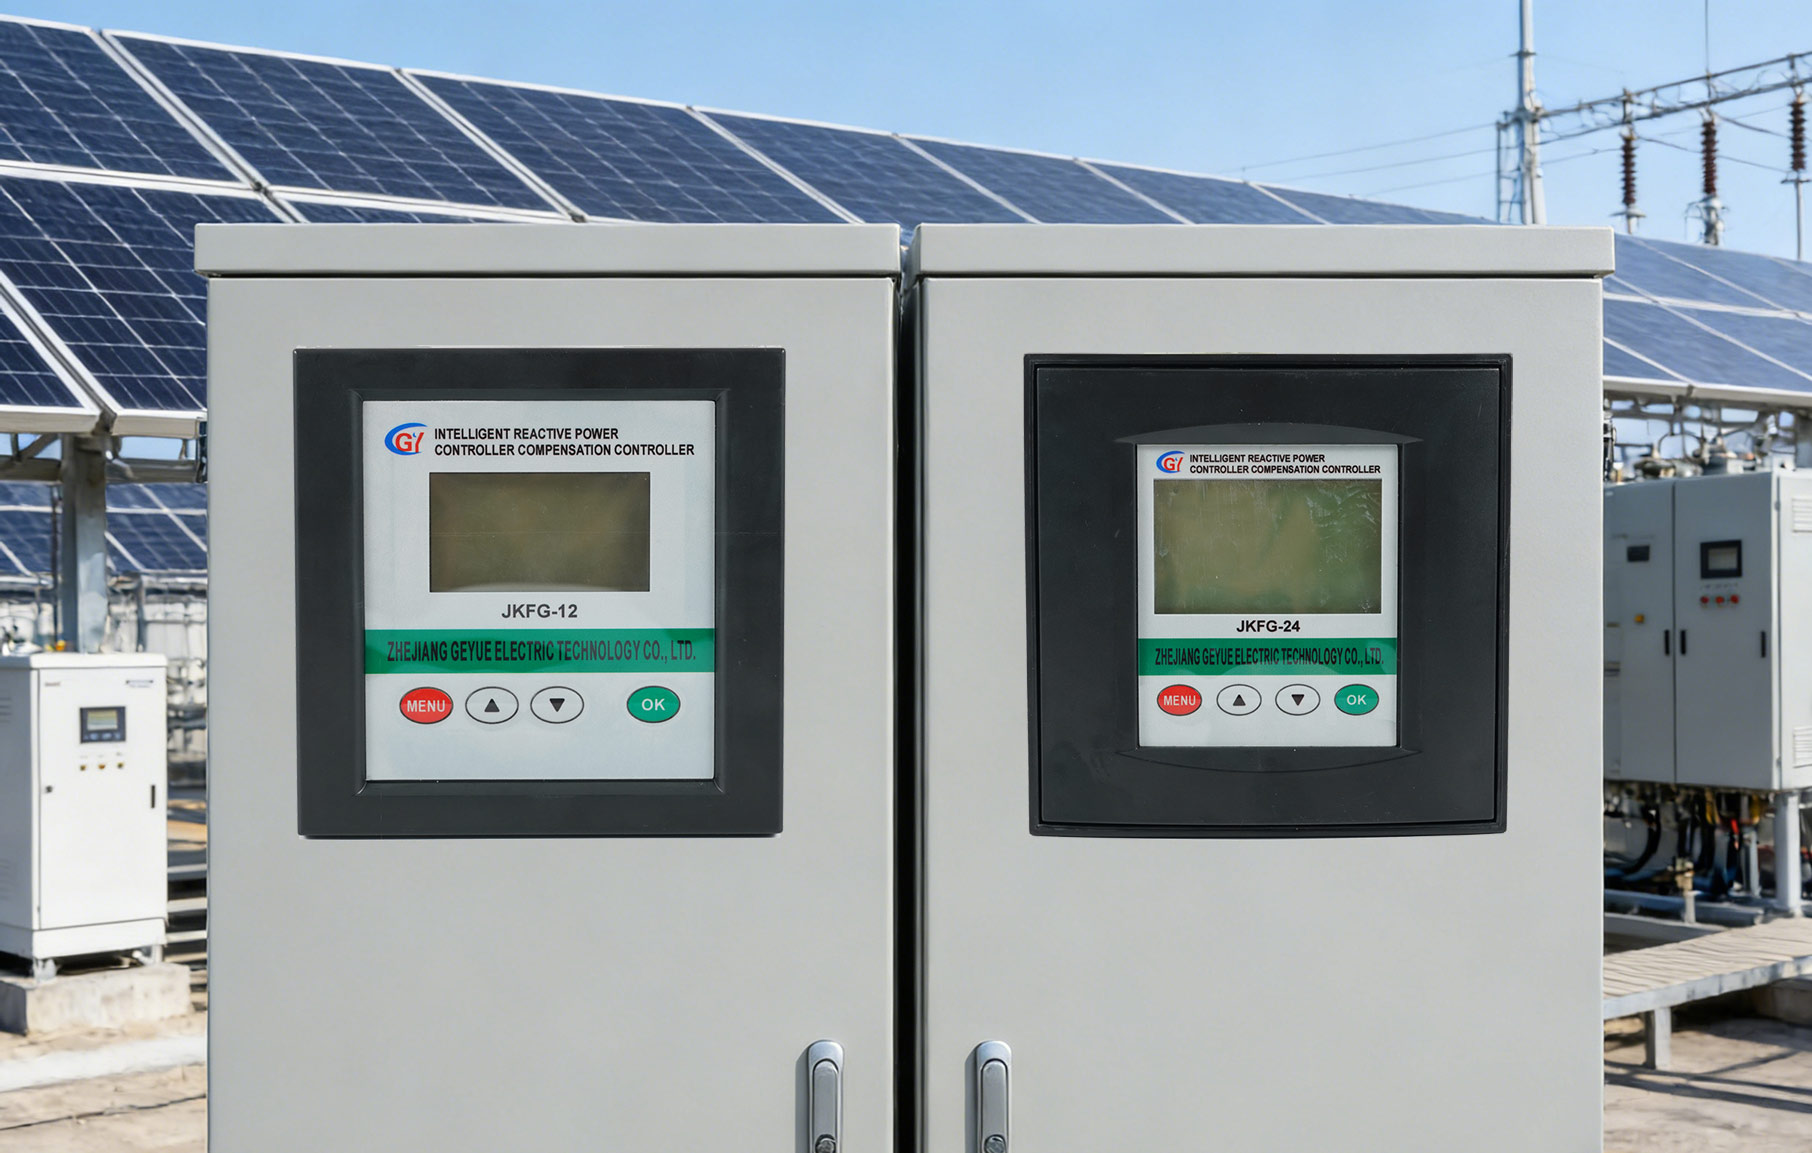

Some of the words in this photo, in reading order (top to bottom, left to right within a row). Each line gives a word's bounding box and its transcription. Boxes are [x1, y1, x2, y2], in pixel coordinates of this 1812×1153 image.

[434, 428, 511, 440] INTELLIGENT
[513, 428, 572, 440] REACTIVE
[575, 428, 619, 440] POWER
[434, 444, 516, 456] CONTROLLER
[517, 444, 613, 456] COMPENSATION
[613, 444, 695, 456] CONTROLLER
[1189, 454, 1246, 463] INTELLIGENT
[1247, 454, 1291, 463] REACTIVE
[1293, 454, 1326, 463] POWER
[1189, 465, 1250, 474] CONTROLLER
[1252, 465, 1321, 474] COMPENSATION
[1322, 465, 1381, 474] CONTROLLER
[501, 603, 578, 619] JKFG-12
[1236, 620, 1301, 633] JKFG-24
[387, 641, 448, 662] ZHEJIANG
[450, 641, 493, 662] GEYUE
[494, 641, 555, 661] ELECTRIC
[556, 640, 640, 661] TECHNOLOGY
[643, 640, 669, 664] CO.,
[670, 640, 697, 661] LTD.
[1155, 648, 1201, 666] ZHEJIANG
[1202, 648, 1233, 665] GEYUE
[1234, 648, 1280, 666] ELECTRIC
[1281, 648, 1344, 665] TECHNOLOGY
[1364, 648, 1384, 665] LTD.
[641, 699, 666, 711] OK
[1163, 695, 1196, 706] MENU
[1346, 695, 1367, 705] OK
[406, 700, 446, 713] MENU
